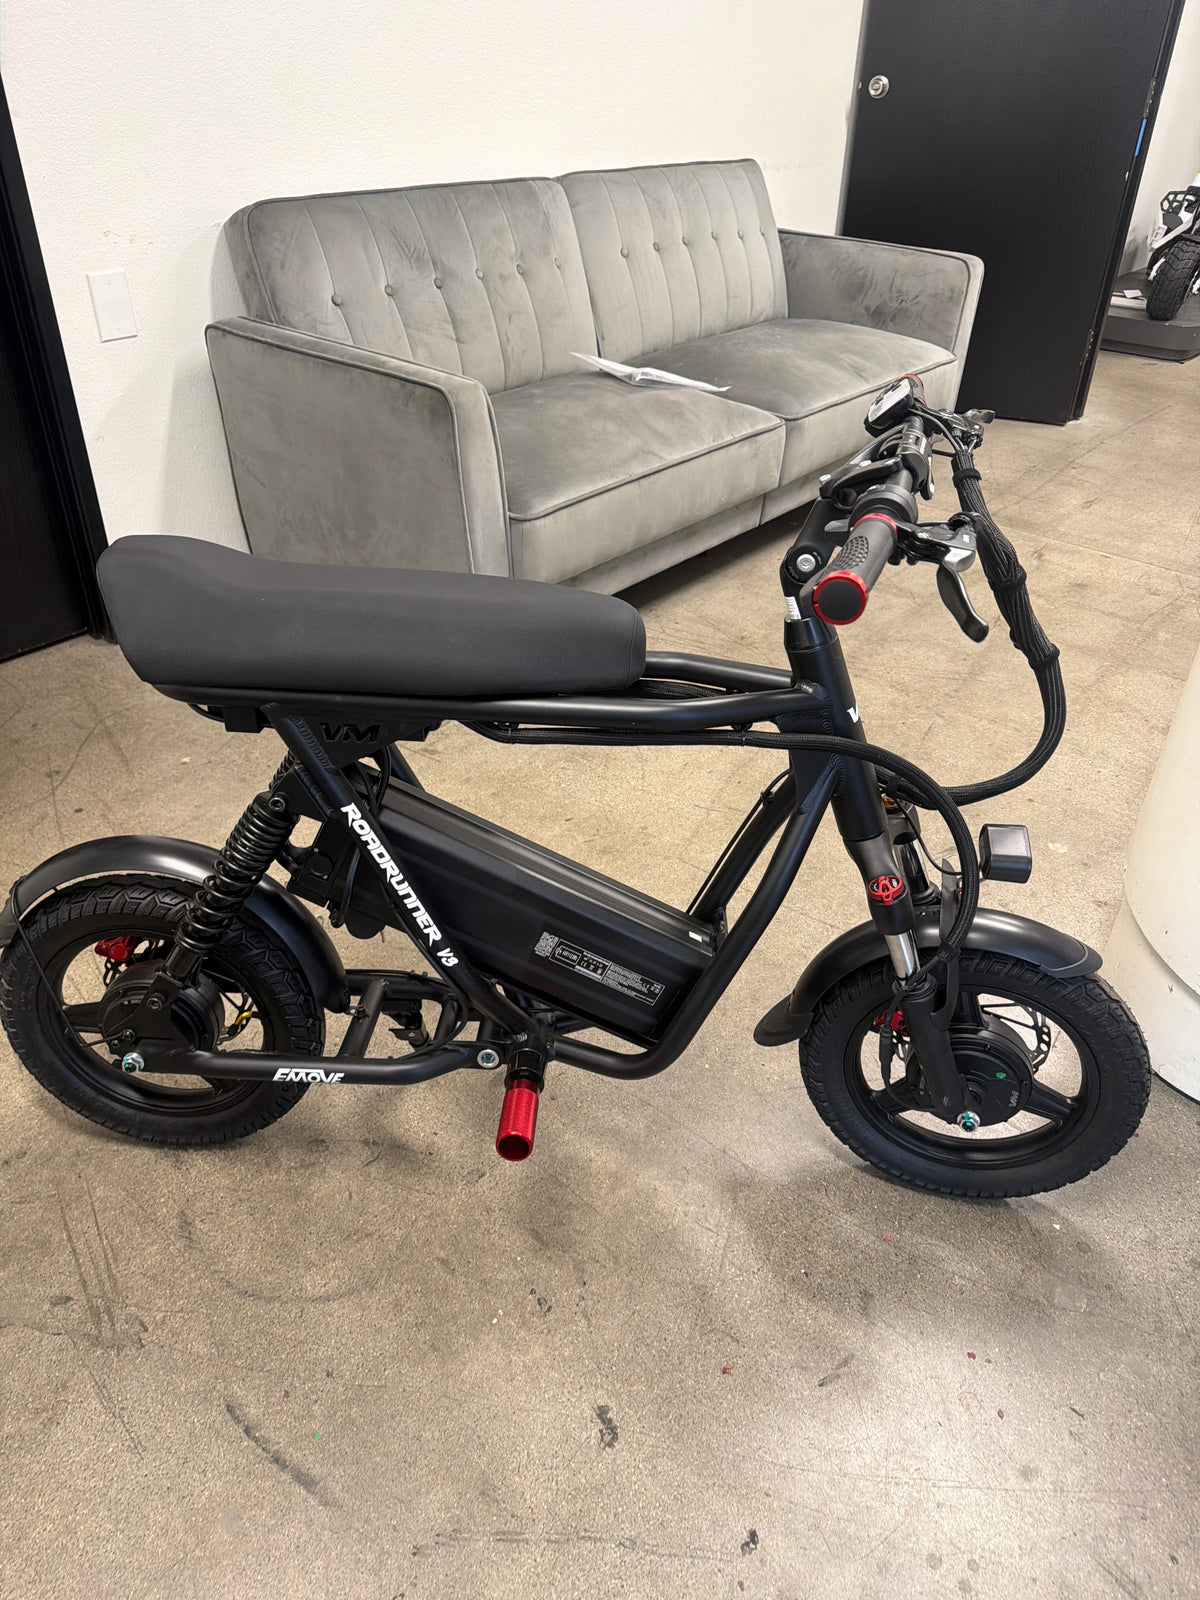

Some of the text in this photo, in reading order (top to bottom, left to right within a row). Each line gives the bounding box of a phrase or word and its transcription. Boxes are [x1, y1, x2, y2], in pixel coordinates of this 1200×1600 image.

[320, 722, 380, 743] VM
[341, 802, 459, 967] ROADRUNNER V3
[272, 1068, 345, 1083] EMOVE
